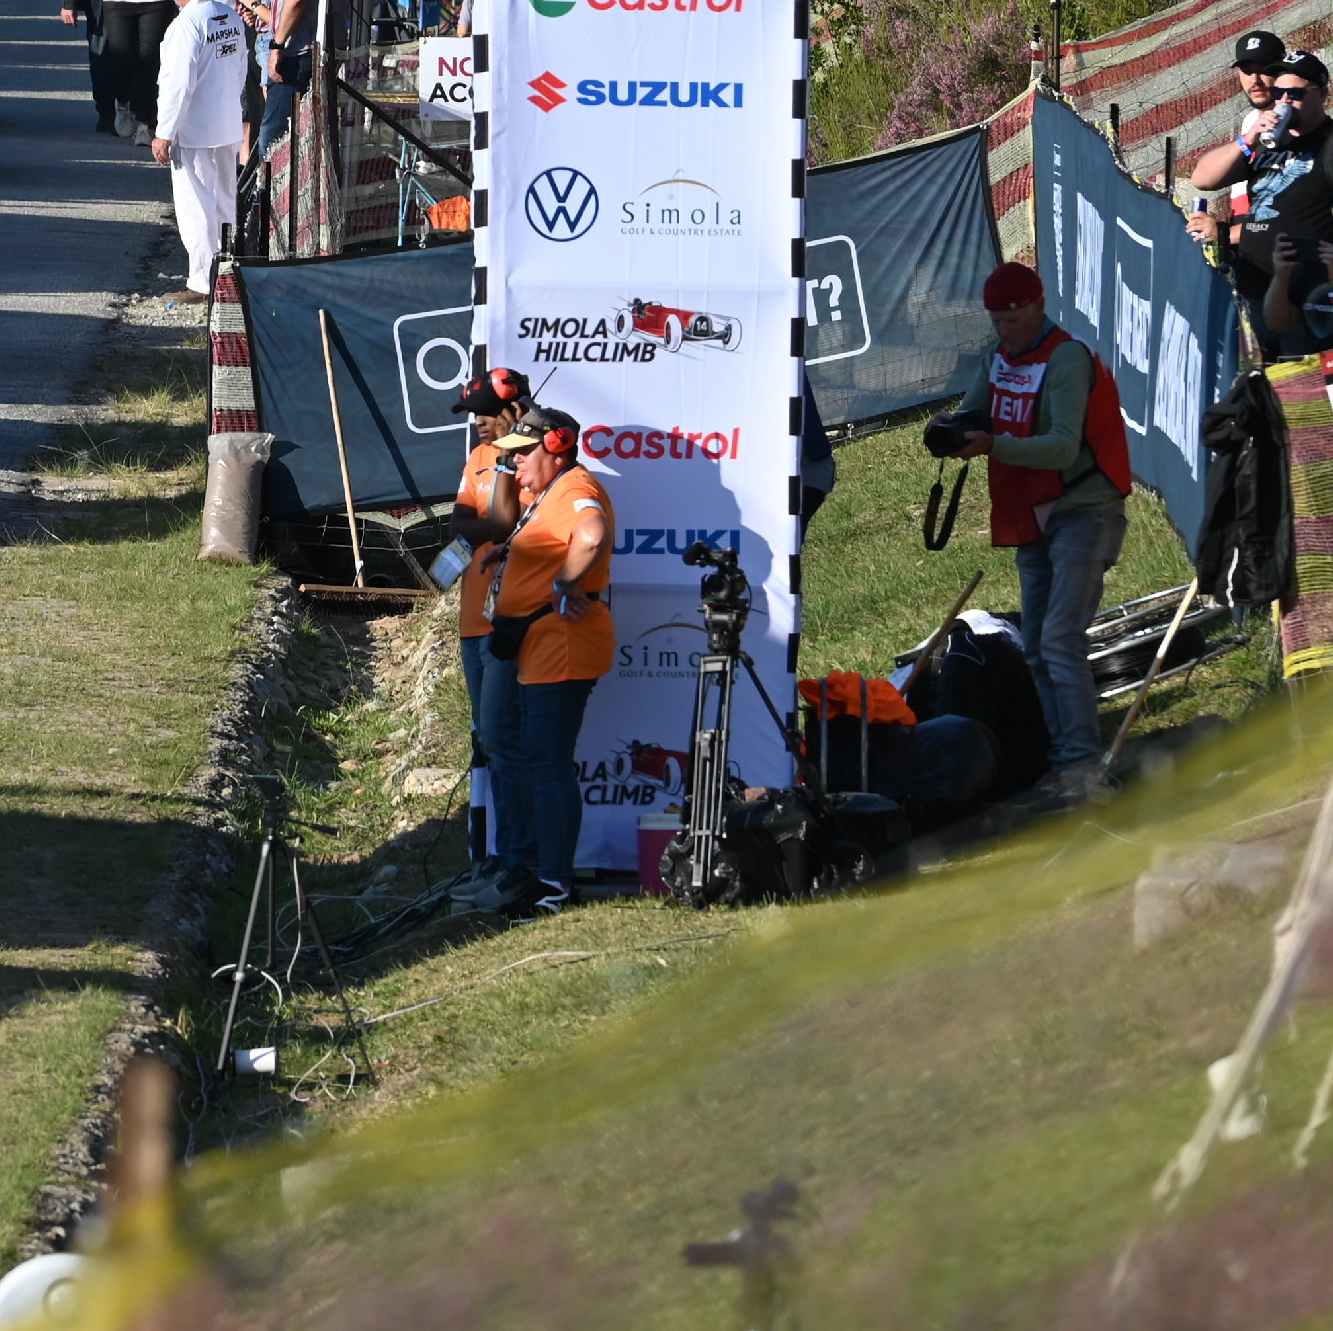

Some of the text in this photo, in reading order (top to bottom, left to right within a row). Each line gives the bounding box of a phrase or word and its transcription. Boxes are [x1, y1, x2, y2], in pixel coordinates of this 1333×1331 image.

[576, 79, 744, 109] SUZUKI
[621, 201, 742, 226] Simola
[620, 227, 743, 237] GOLF & COUNTRY ESTATE
[518, 317, 608, 339] SIMOLA
[696, 320, 709, 333] 14
[533, 341, 656, 363] HILLCLIMB
[582, 424, 740, 460] Castrol
[613, 528, 740, 555] UZUKI
[656, 671, 697, 679] COUNTR
[584, 784, 657, 806] CLIMB
